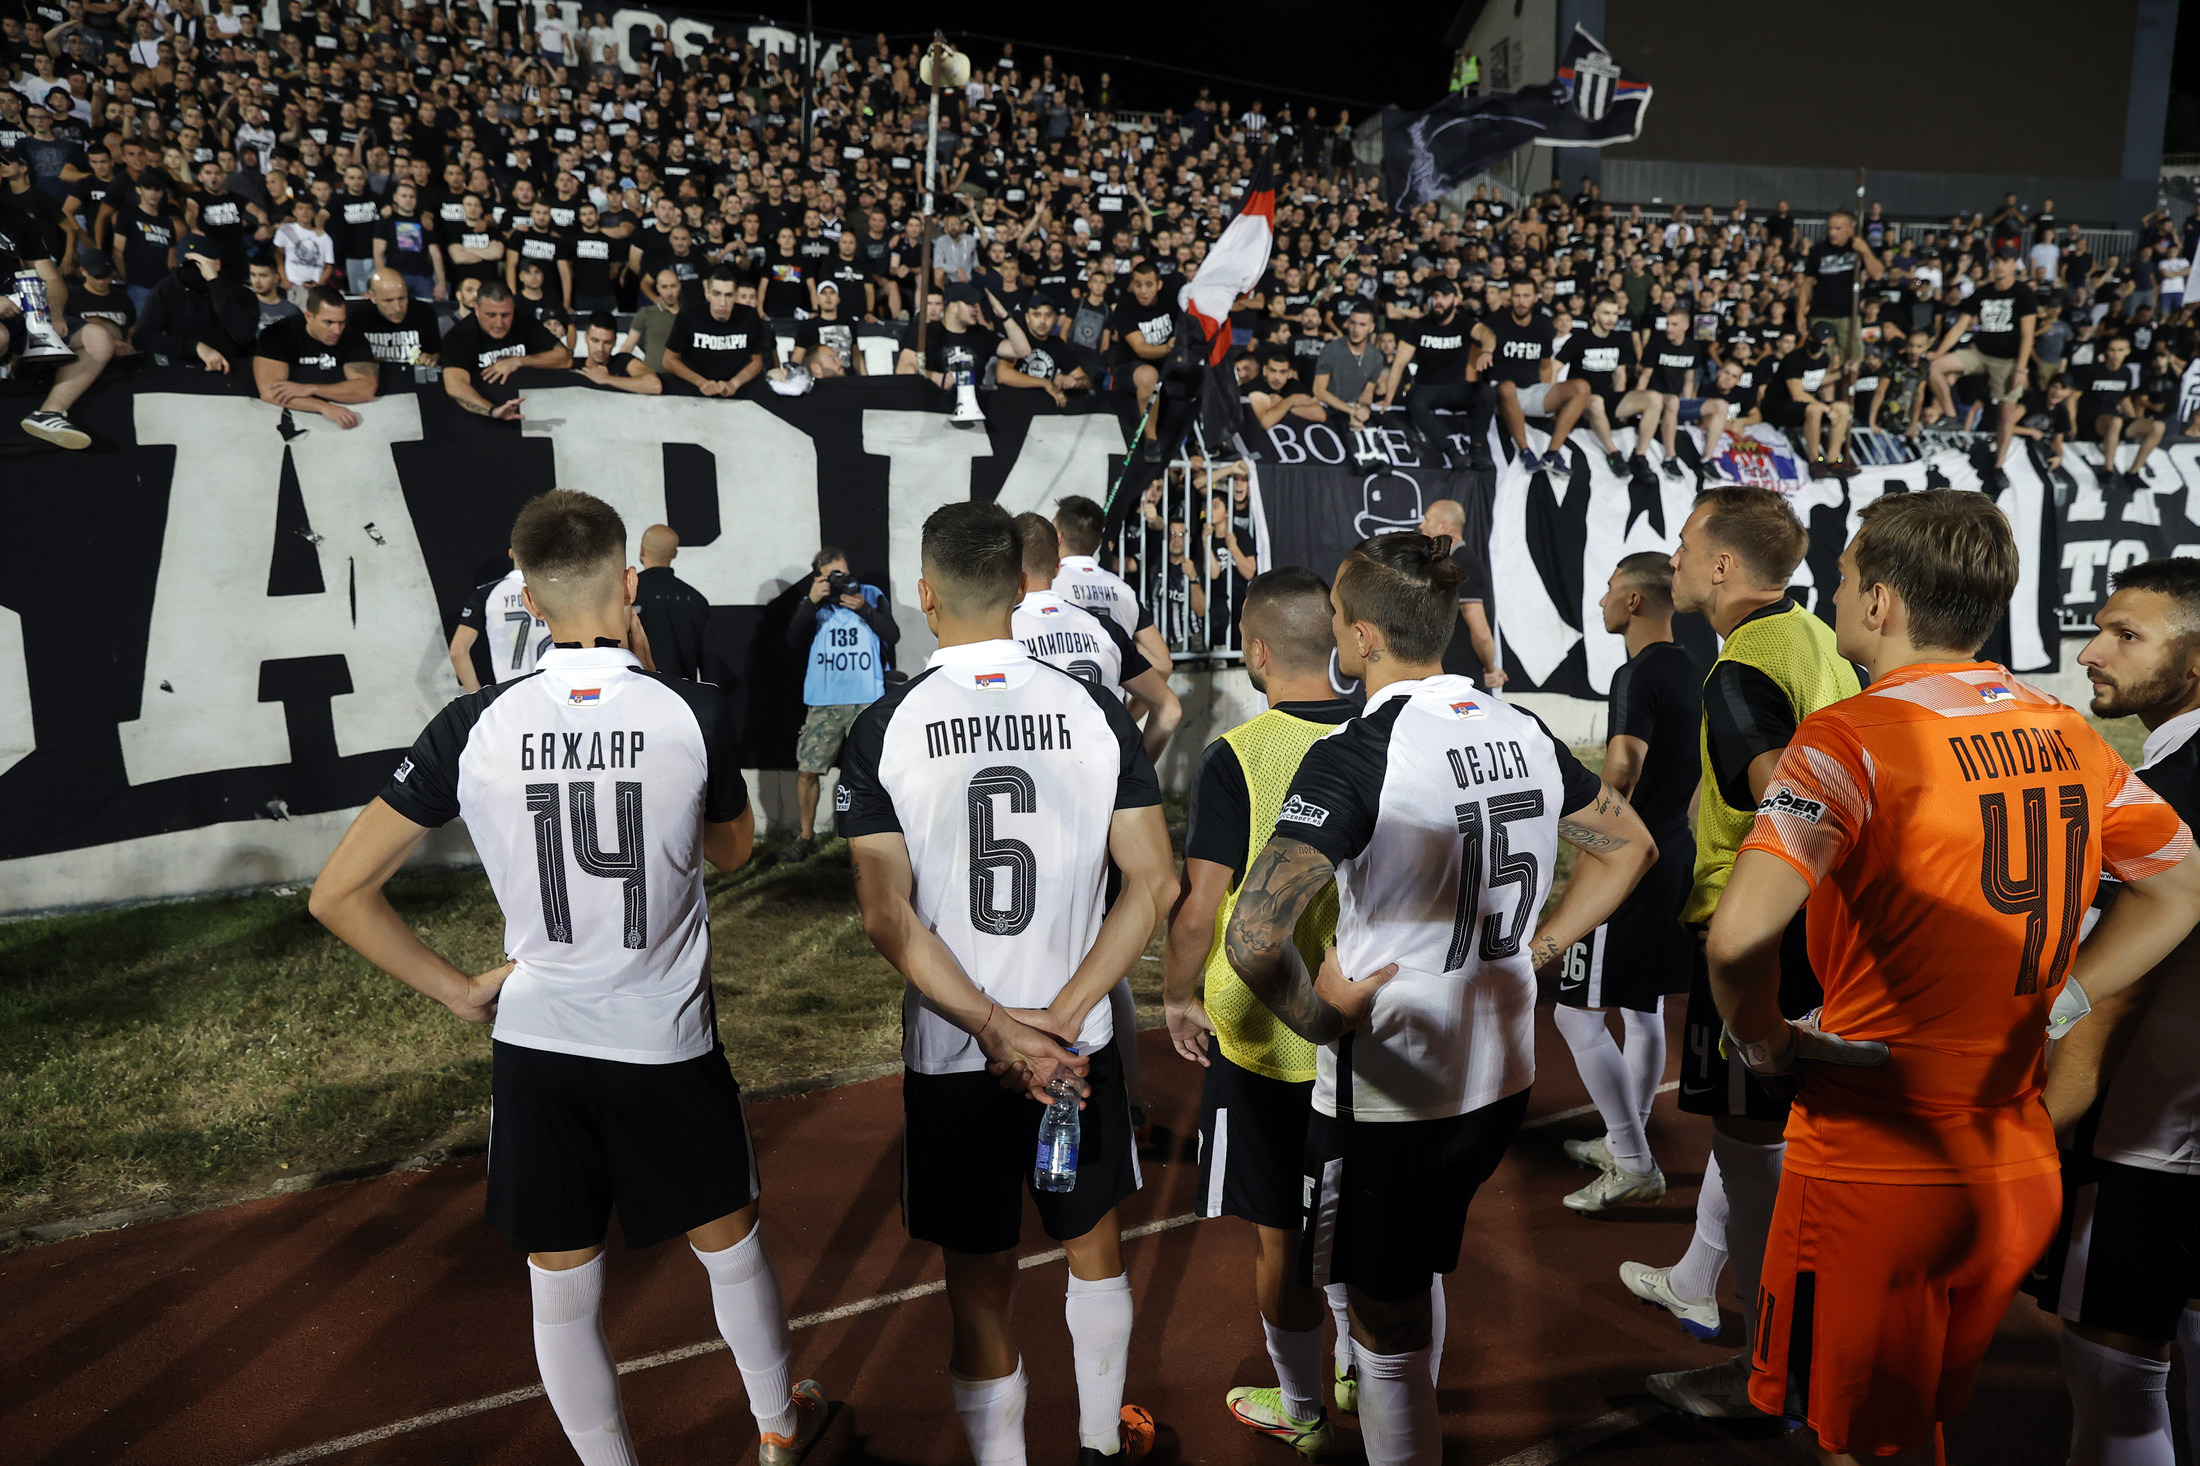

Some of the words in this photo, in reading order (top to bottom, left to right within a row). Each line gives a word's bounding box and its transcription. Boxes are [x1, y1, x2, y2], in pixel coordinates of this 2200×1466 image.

[693, 332, 747, 350] ГРОБАРИ
[503, 595, 524, 608] УРО
[1072, 585, 1119, 602] ВУЈАЧИЋ
[829, 627, 858, 647] 138
[817, 652, 872, 671] PHOTO
[521, 731, 644, 771] БАЖДАР
[925, 713, 1072, 759] МАРКОВИЋ
[1948, 728, 2081, 782] ПОПОВИЋ
[1446, 740, 1530, 789] ФЕЈСА
[525, 781, 648, 950] 14
[967, 765, 1037, 936] 6
[1443, 789, 1545, 974] 15
[1979, 784, 2090, 997] 41
[1690, 1023, 1710, 1079] 4
